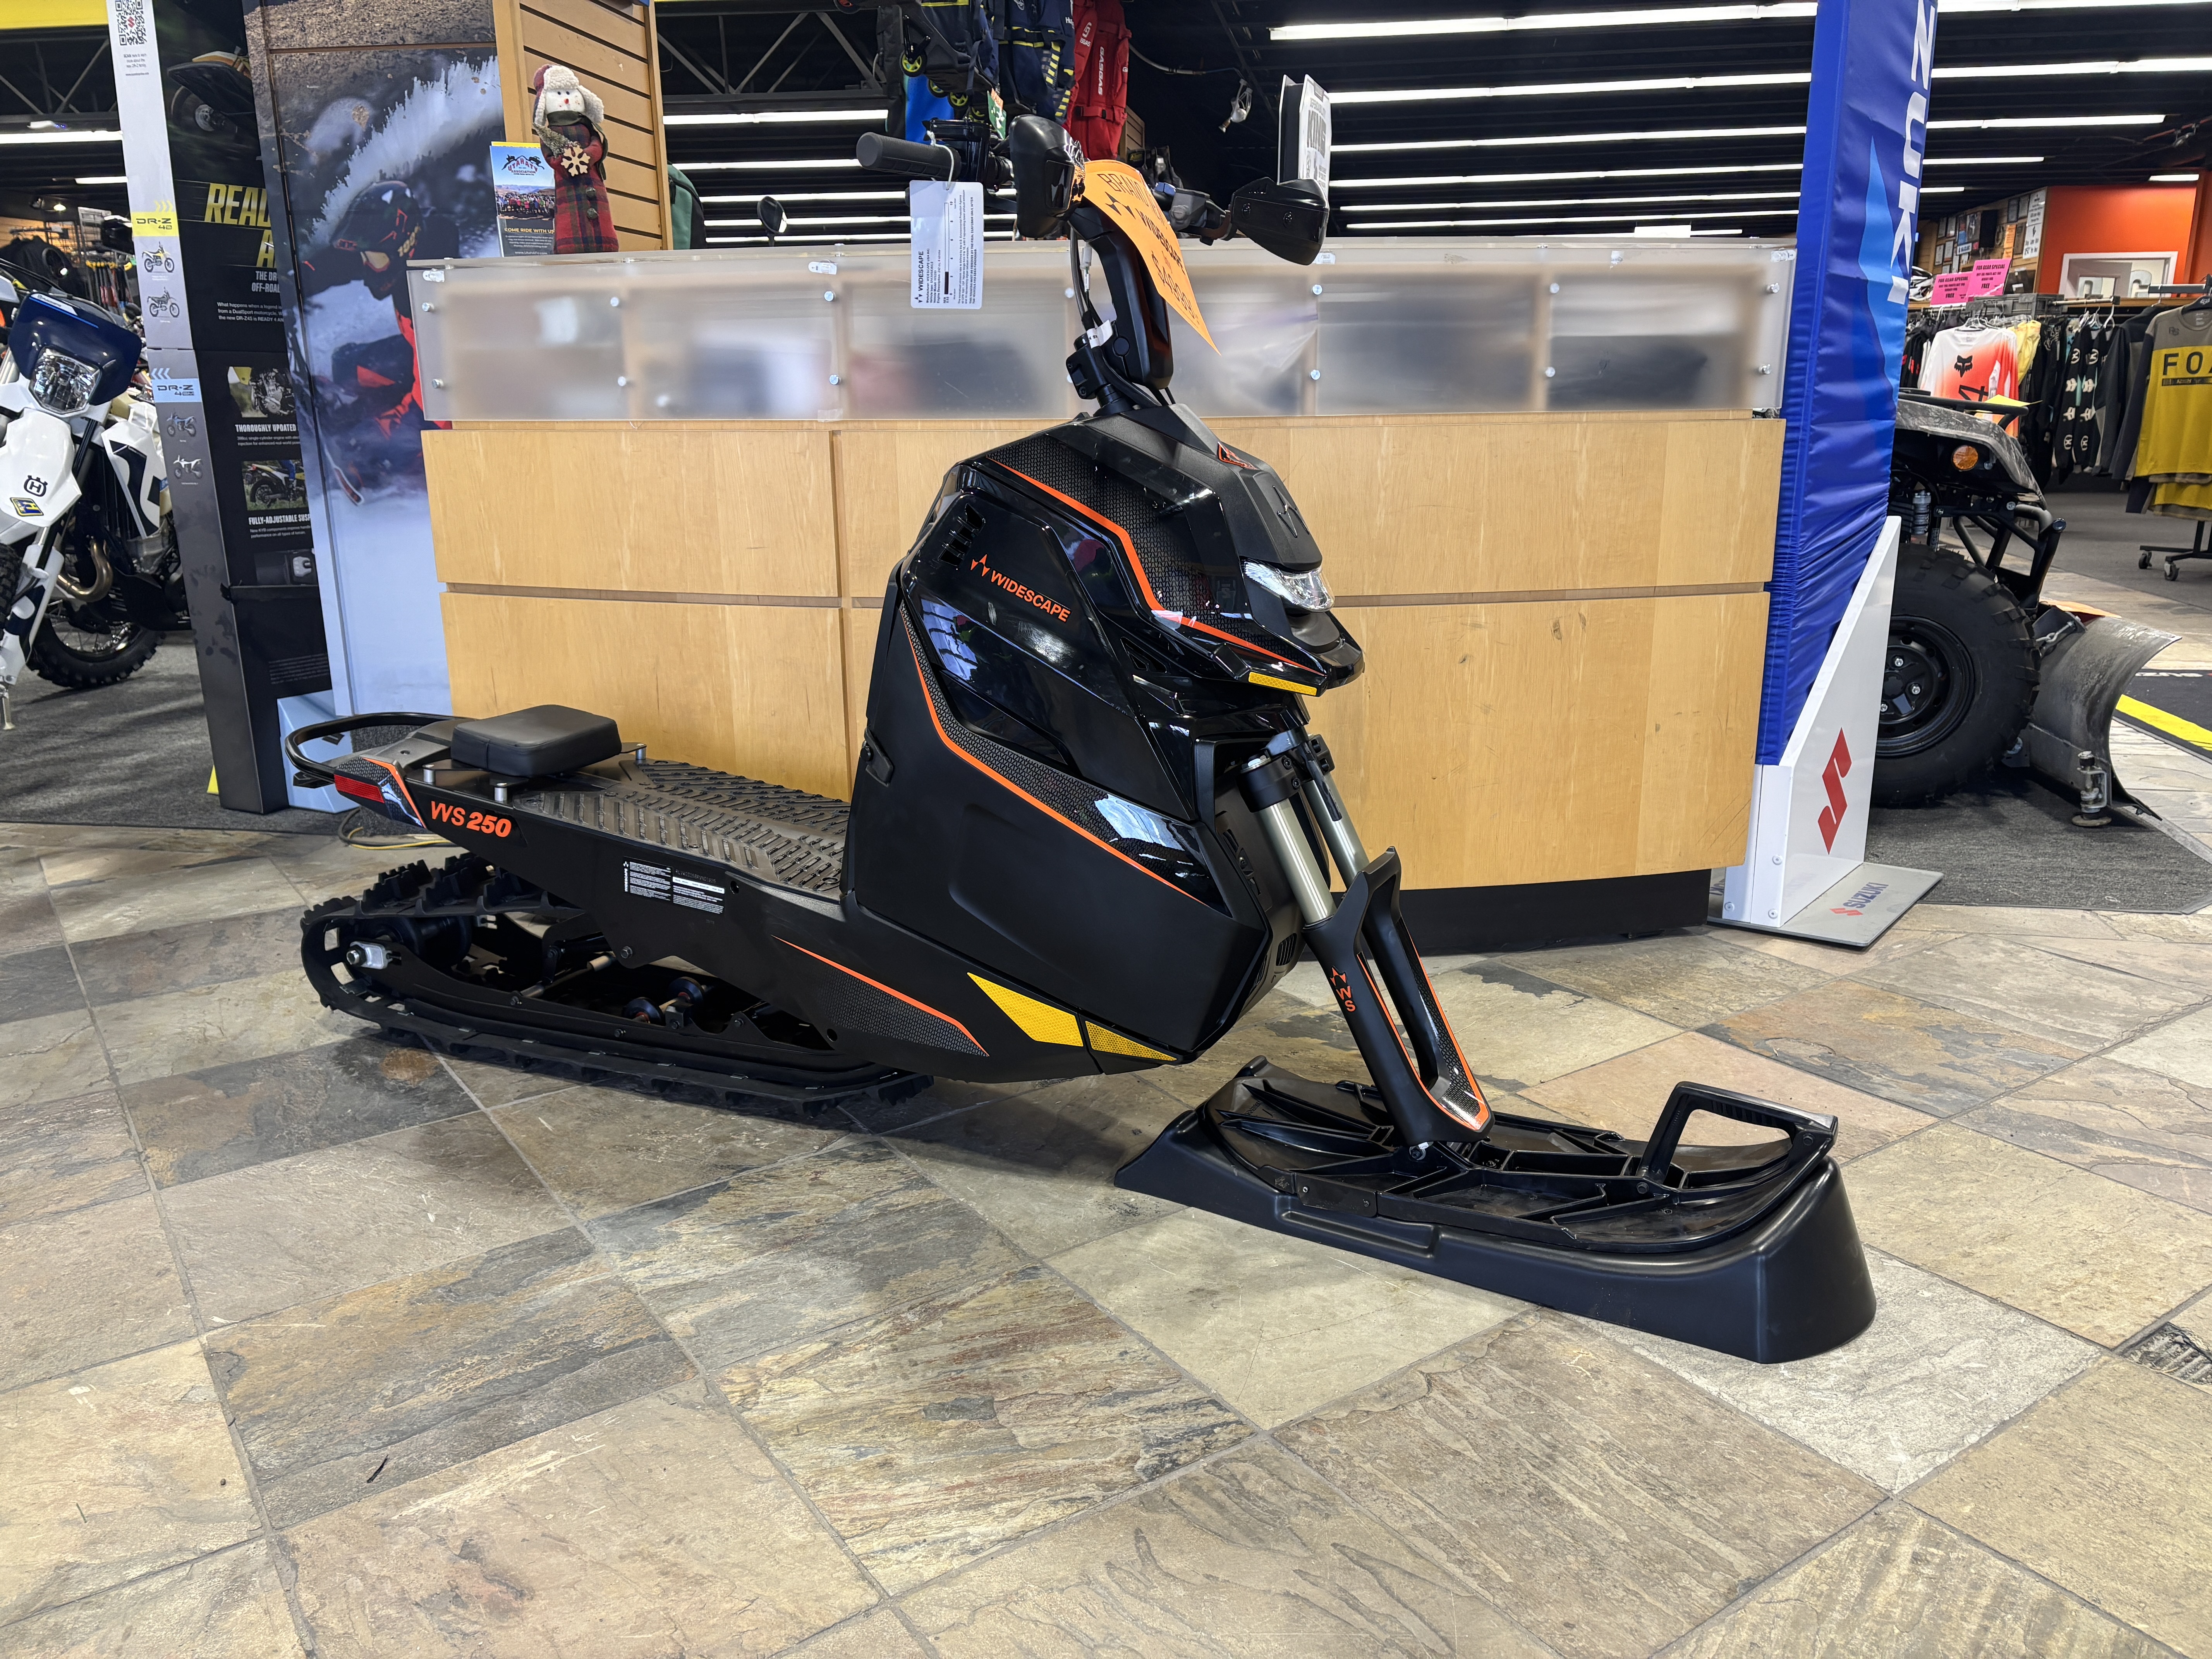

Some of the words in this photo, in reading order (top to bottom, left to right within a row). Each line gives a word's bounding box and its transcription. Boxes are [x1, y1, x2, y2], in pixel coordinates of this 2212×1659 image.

[1307, 110, 1326, 159] KING
[1097, 174, 1149, 207] BRAND
[256, 271, 267, 280] THE
[2163, 351, 2212, 376] FO
[235, 424, 271, 432] THOROUGHLY
[248, 514, 298, 525] FULLY-ADJUSTABLE
[991, 570, 1071, 622] WIDESCAPE
[431, 801, 465, 826] WS
[466, 812, 512, 837] 250
[1843, 882, 1889, 909] SUZUKI
